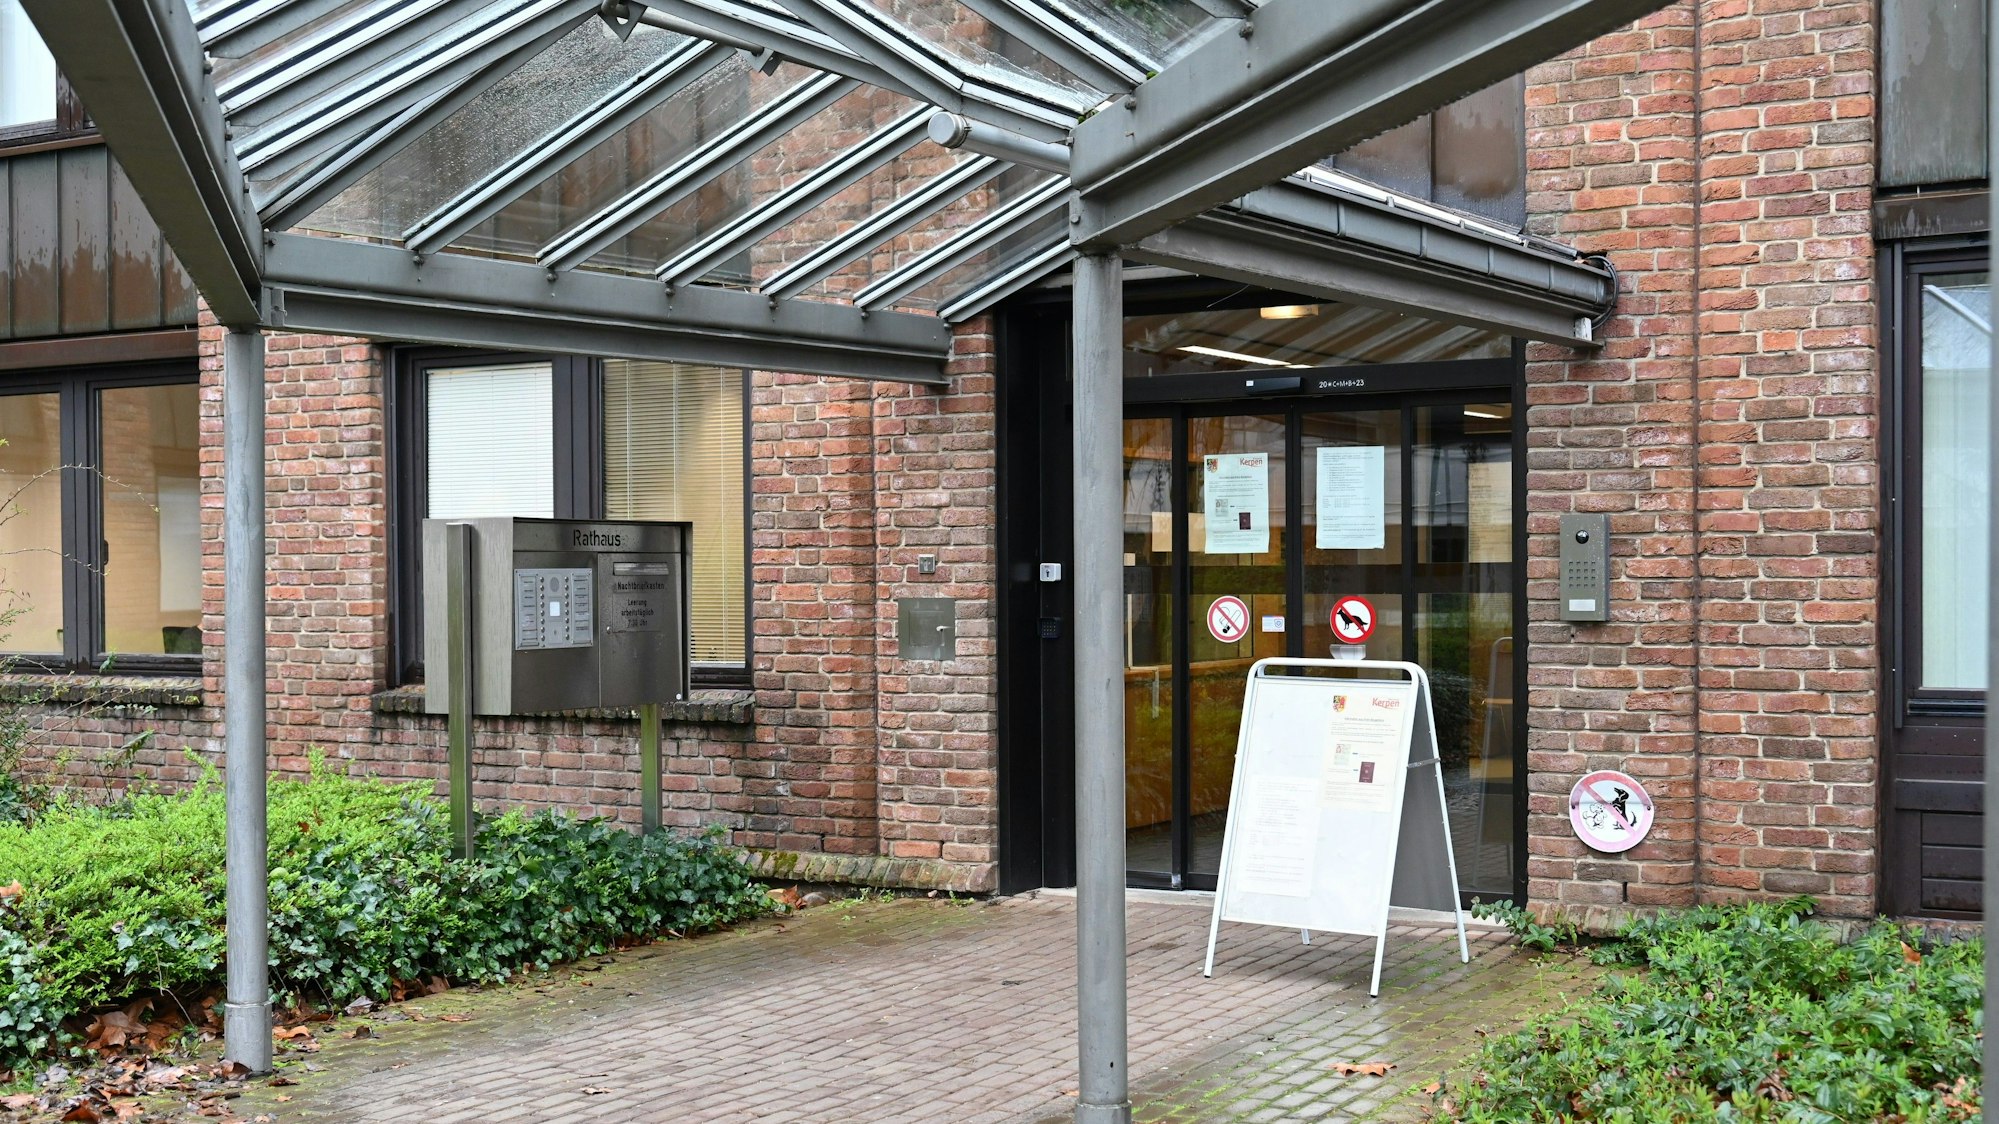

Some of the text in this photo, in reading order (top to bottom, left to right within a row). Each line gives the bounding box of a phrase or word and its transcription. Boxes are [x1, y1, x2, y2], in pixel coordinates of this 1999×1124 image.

[1240, 458, 1263, 467] Kerpen
[573, 529, 621, 546] Rathaus
[617, 581, 665, 590] Nachtbriefkasten
[627, 598, 647, 607] Leerung
[1372, 697, 1400, 709] Kerpen
